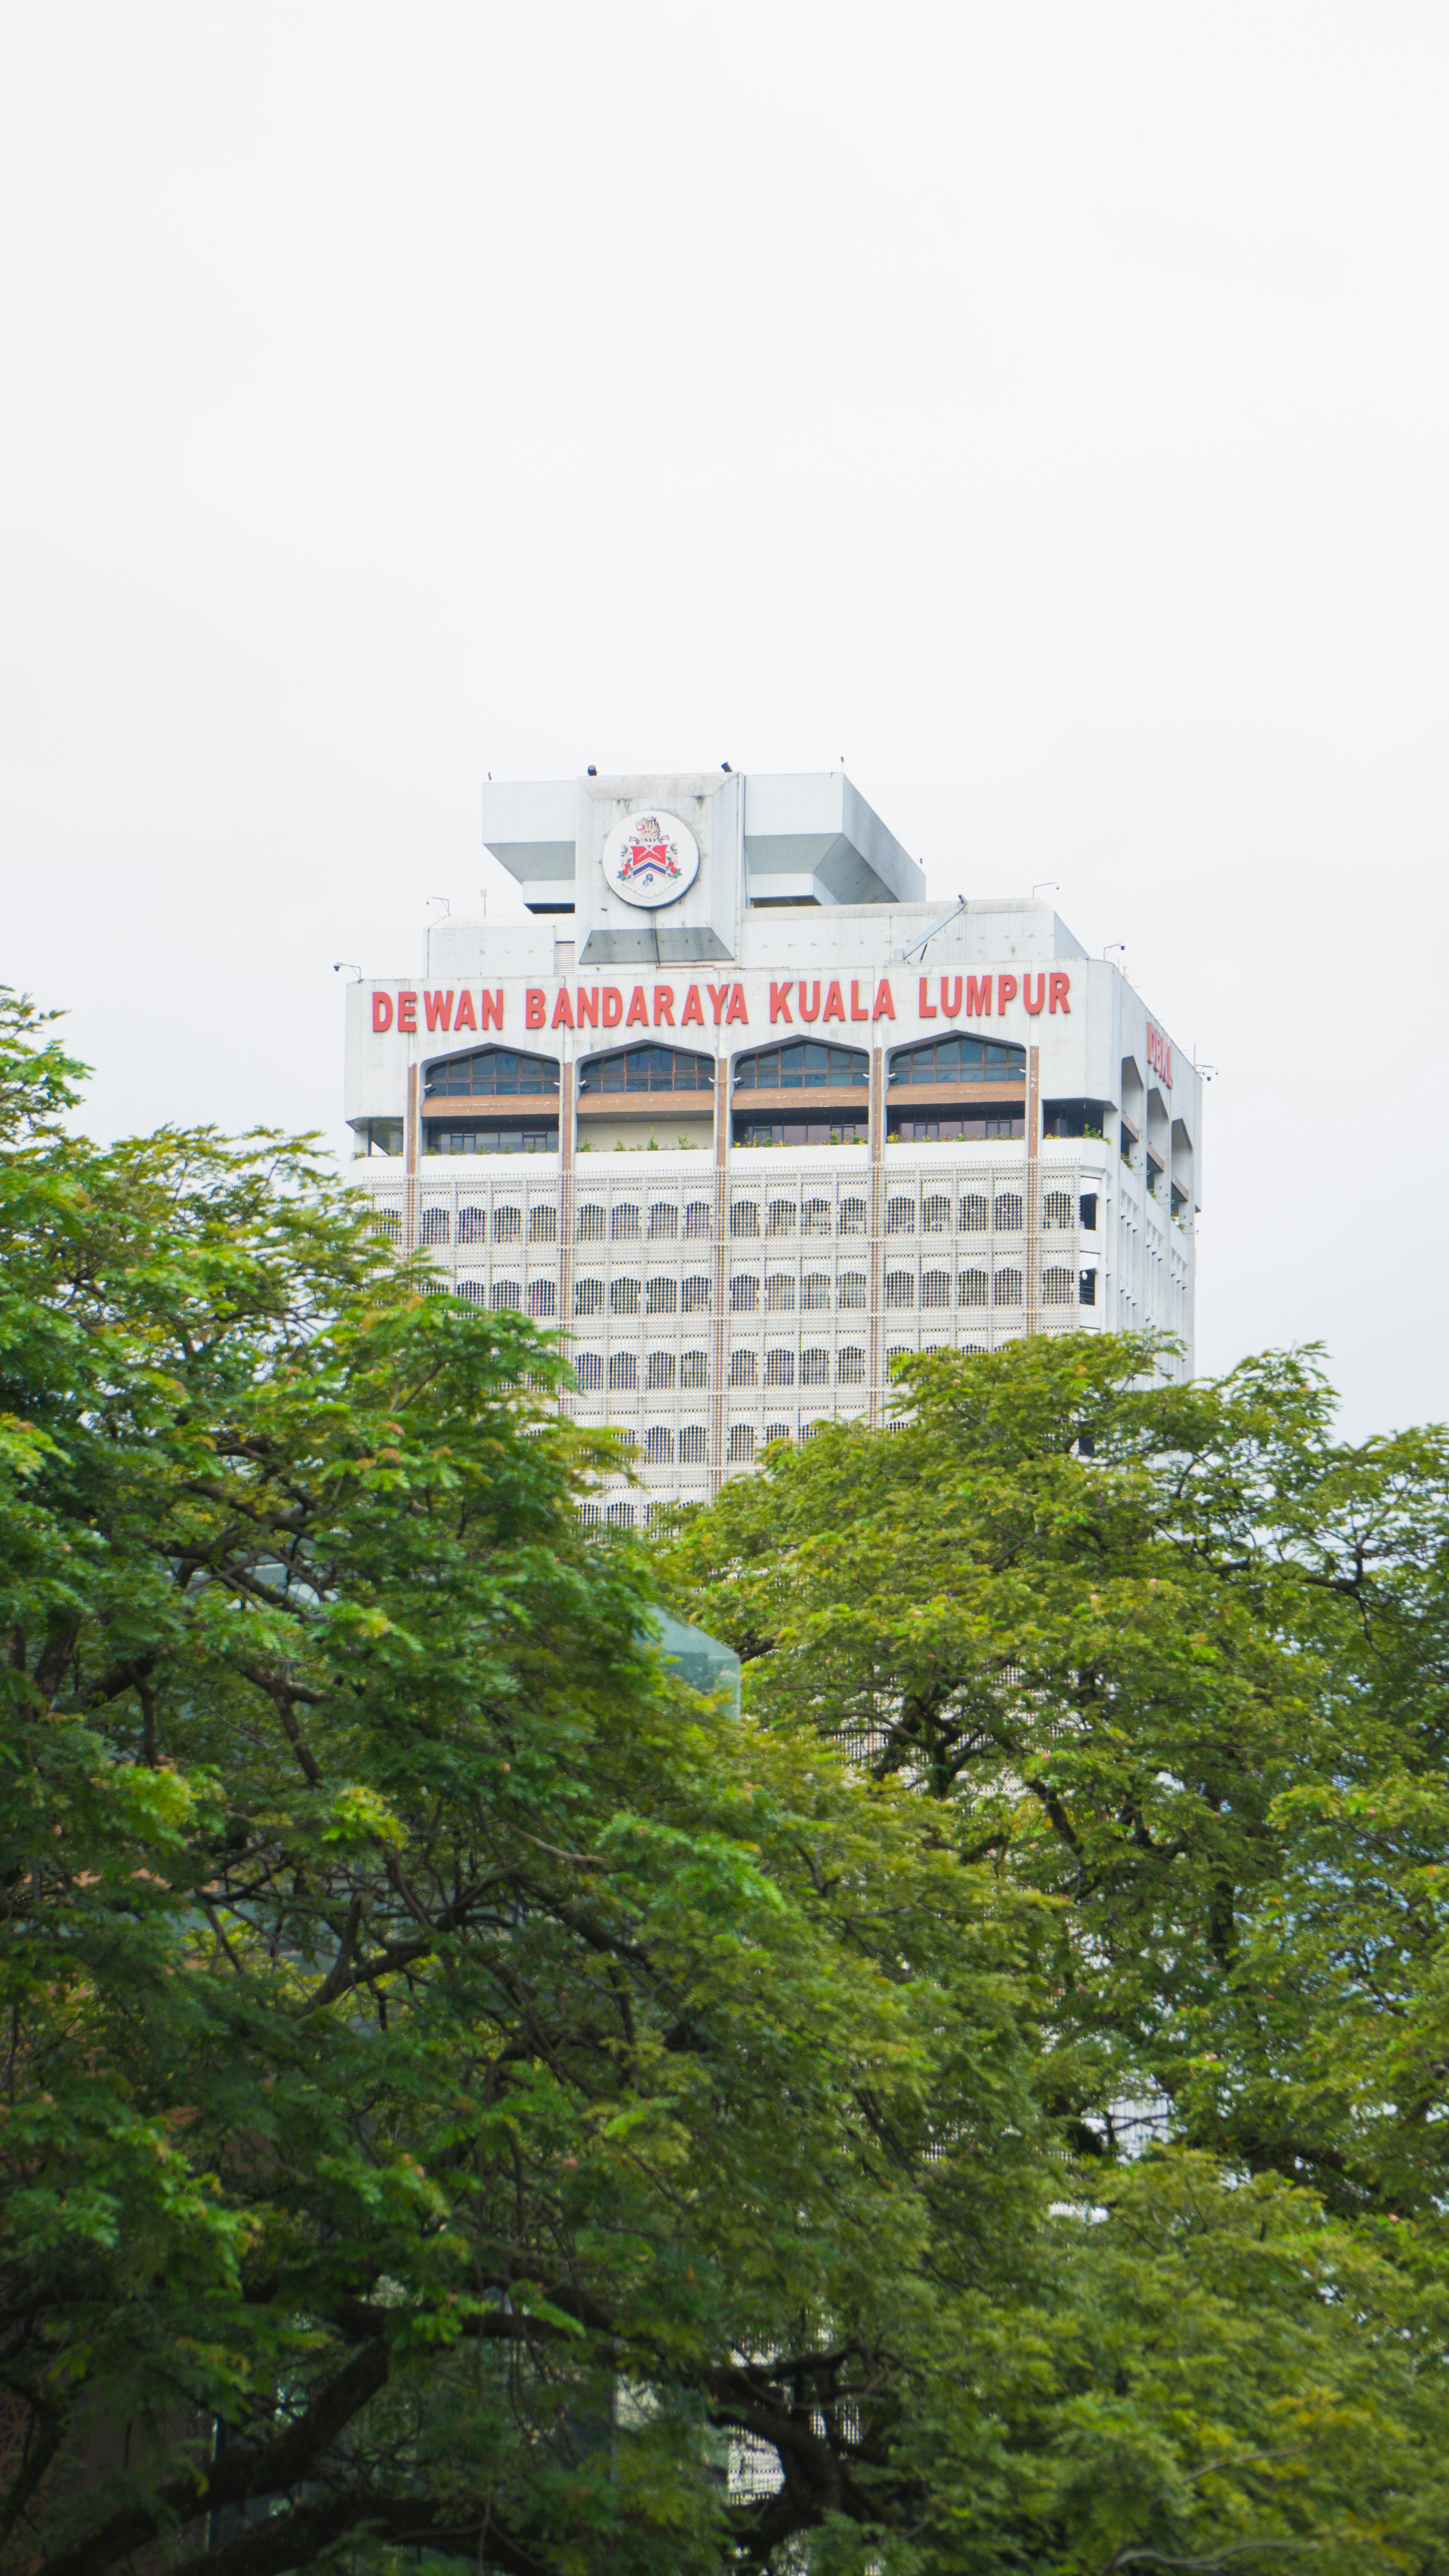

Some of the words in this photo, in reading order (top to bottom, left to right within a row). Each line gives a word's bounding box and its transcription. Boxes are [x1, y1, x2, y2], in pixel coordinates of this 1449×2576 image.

[373, 990, 503, 1031] DEWAN
[526, 984, 748, 1027] BANDARAYA
[770, 980, 895, 1022] KUALA
[919, 973, 1069, 1016] LUMPUR
[1147, 1021, 1173, 1090] DBKL
